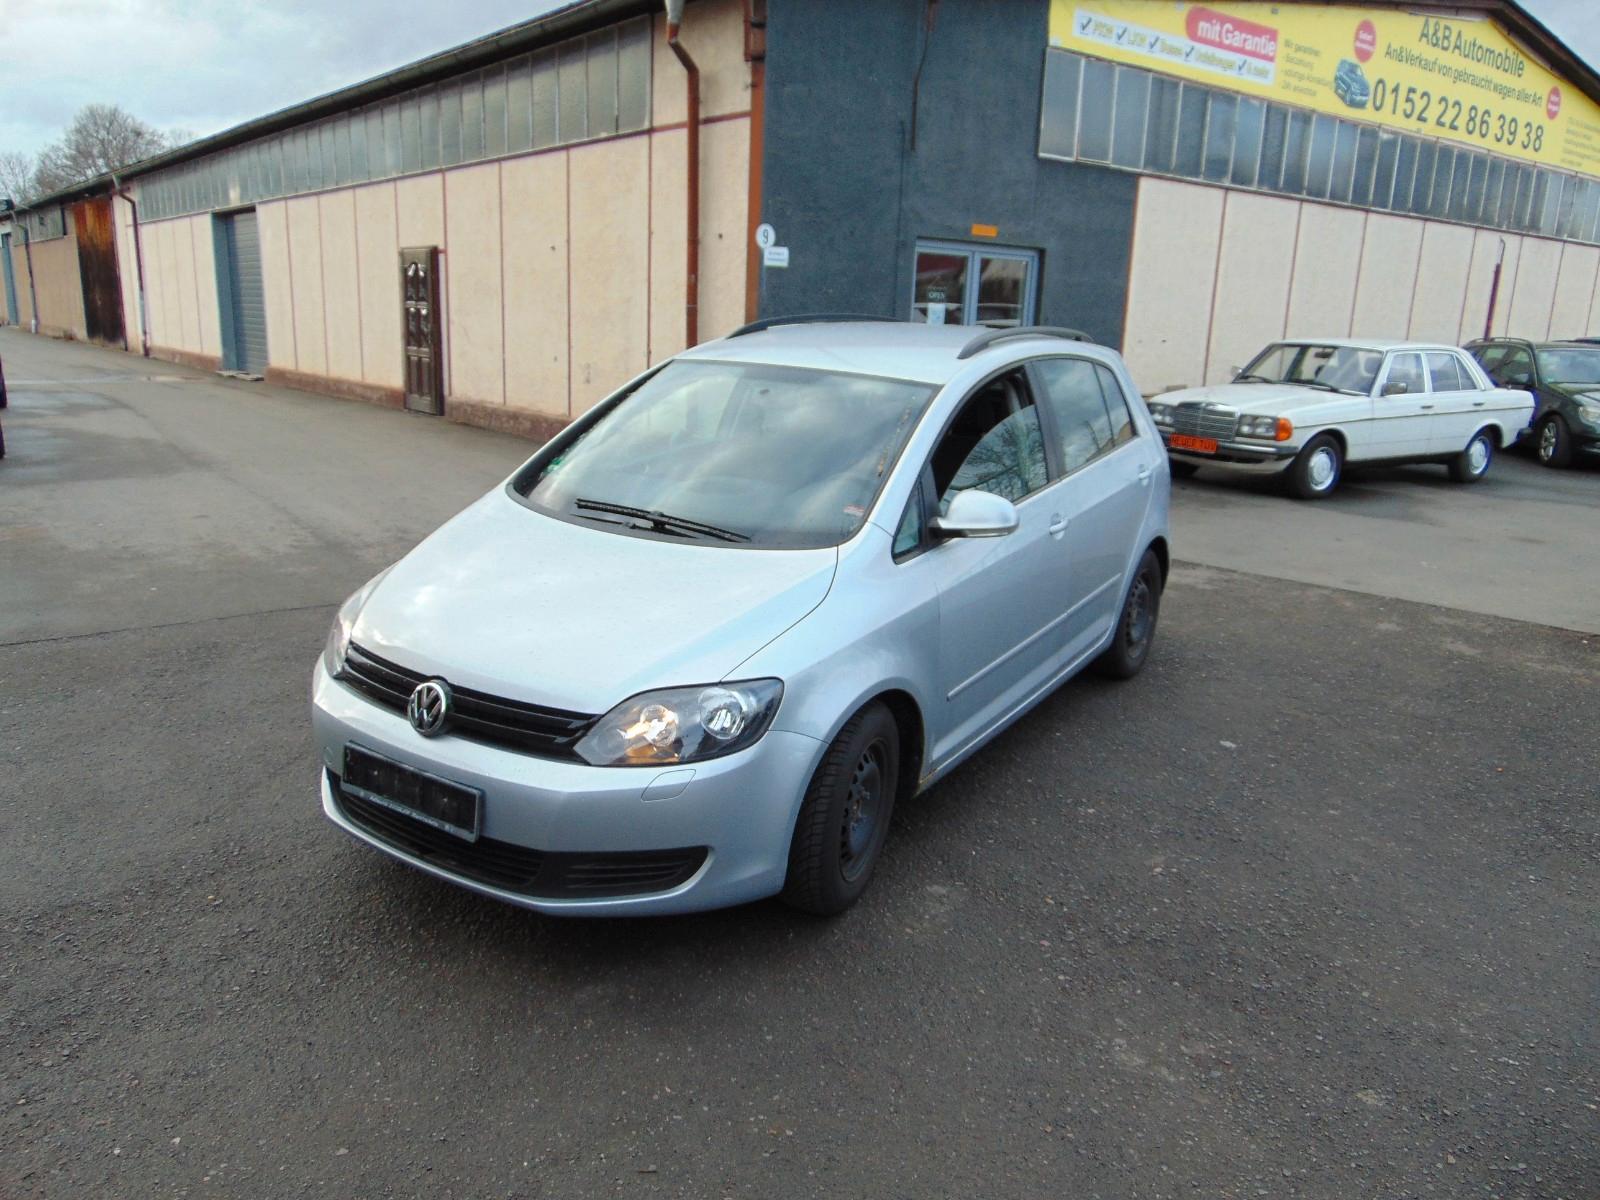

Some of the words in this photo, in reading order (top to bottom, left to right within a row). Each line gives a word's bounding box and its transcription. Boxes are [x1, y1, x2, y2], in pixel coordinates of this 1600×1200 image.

[1197, 20, 1220, 42] mit
[1222, 23, 1276, 56] Garantie
[1418, 16, 1451, 51] A&B
[1452, 30, 1525, 77] Automobile
[1438, 62, 1453, 77] von
[762, 228, 769, 244] 9
[409, 684, 444, 732] VW
